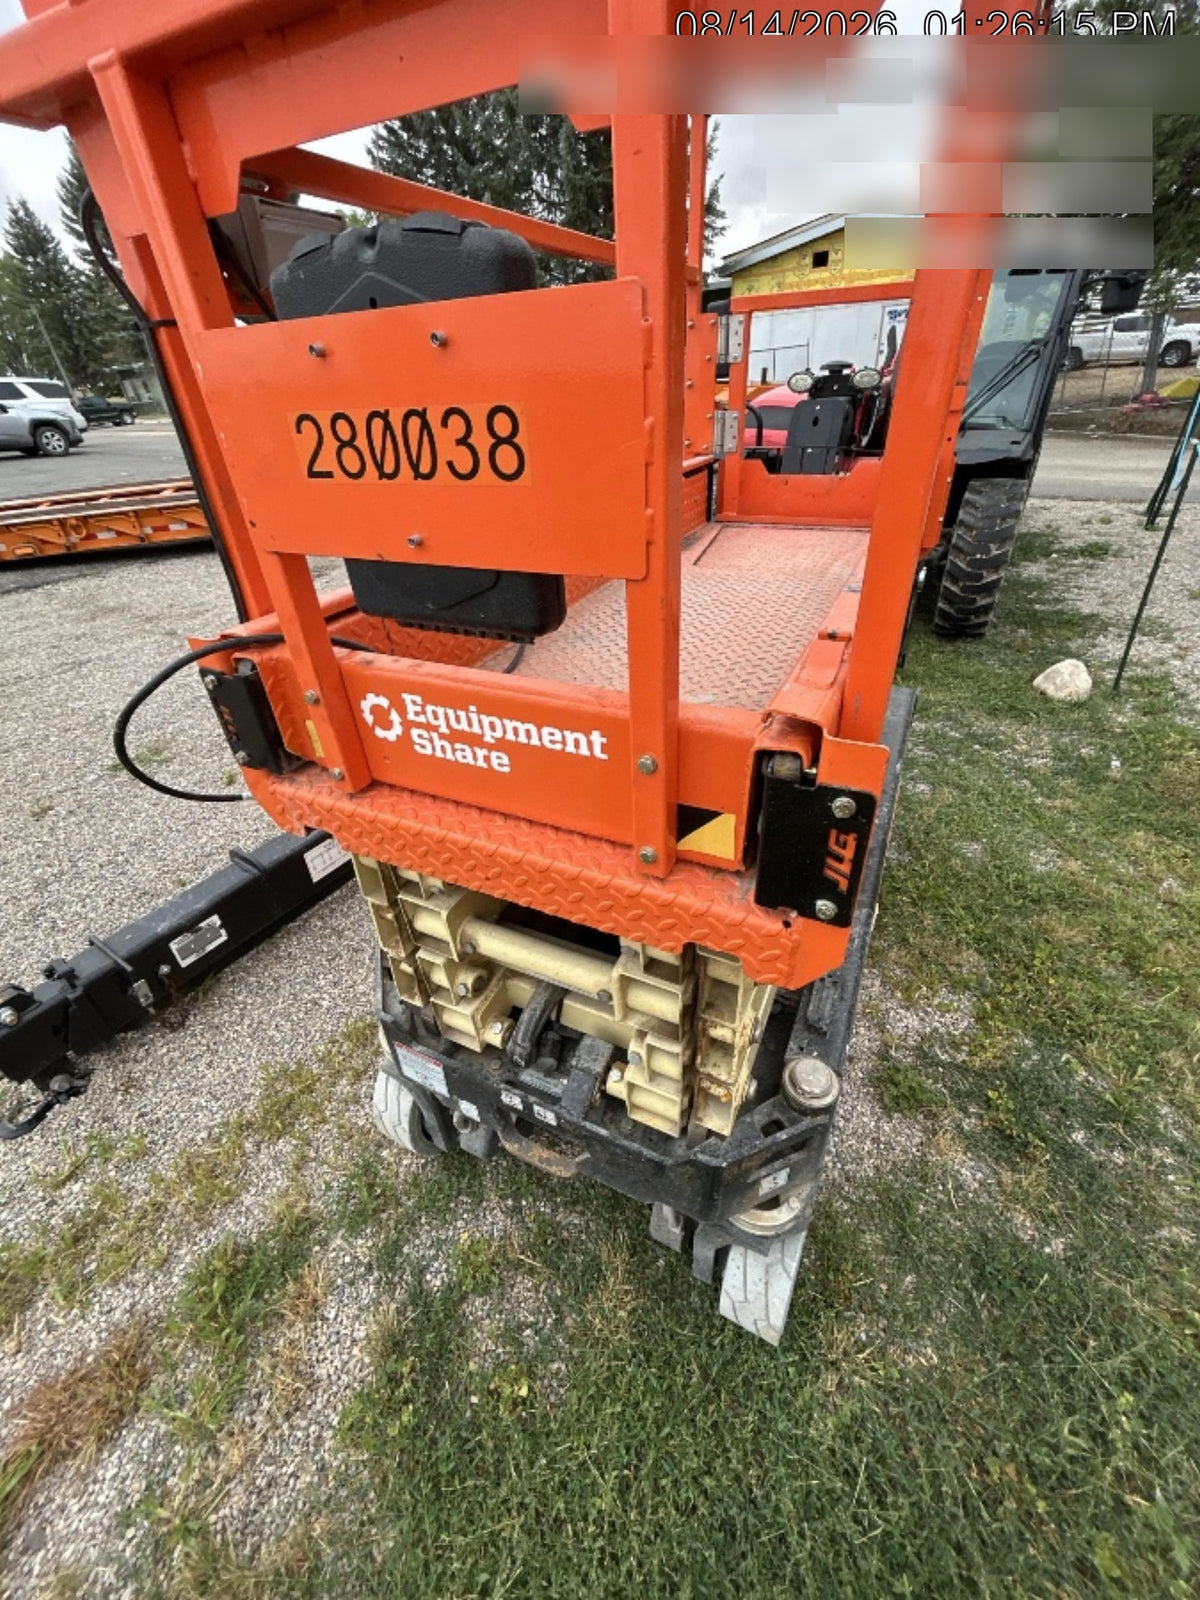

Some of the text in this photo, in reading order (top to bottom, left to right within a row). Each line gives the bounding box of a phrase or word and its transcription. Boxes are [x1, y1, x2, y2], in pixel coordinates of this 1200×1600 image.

[295, 404, 526, 483] 280038
[401, 692, 609, 760] Equipment
[410, 727, 512, 774] Share
[822, 827, 858, 896] JLG
